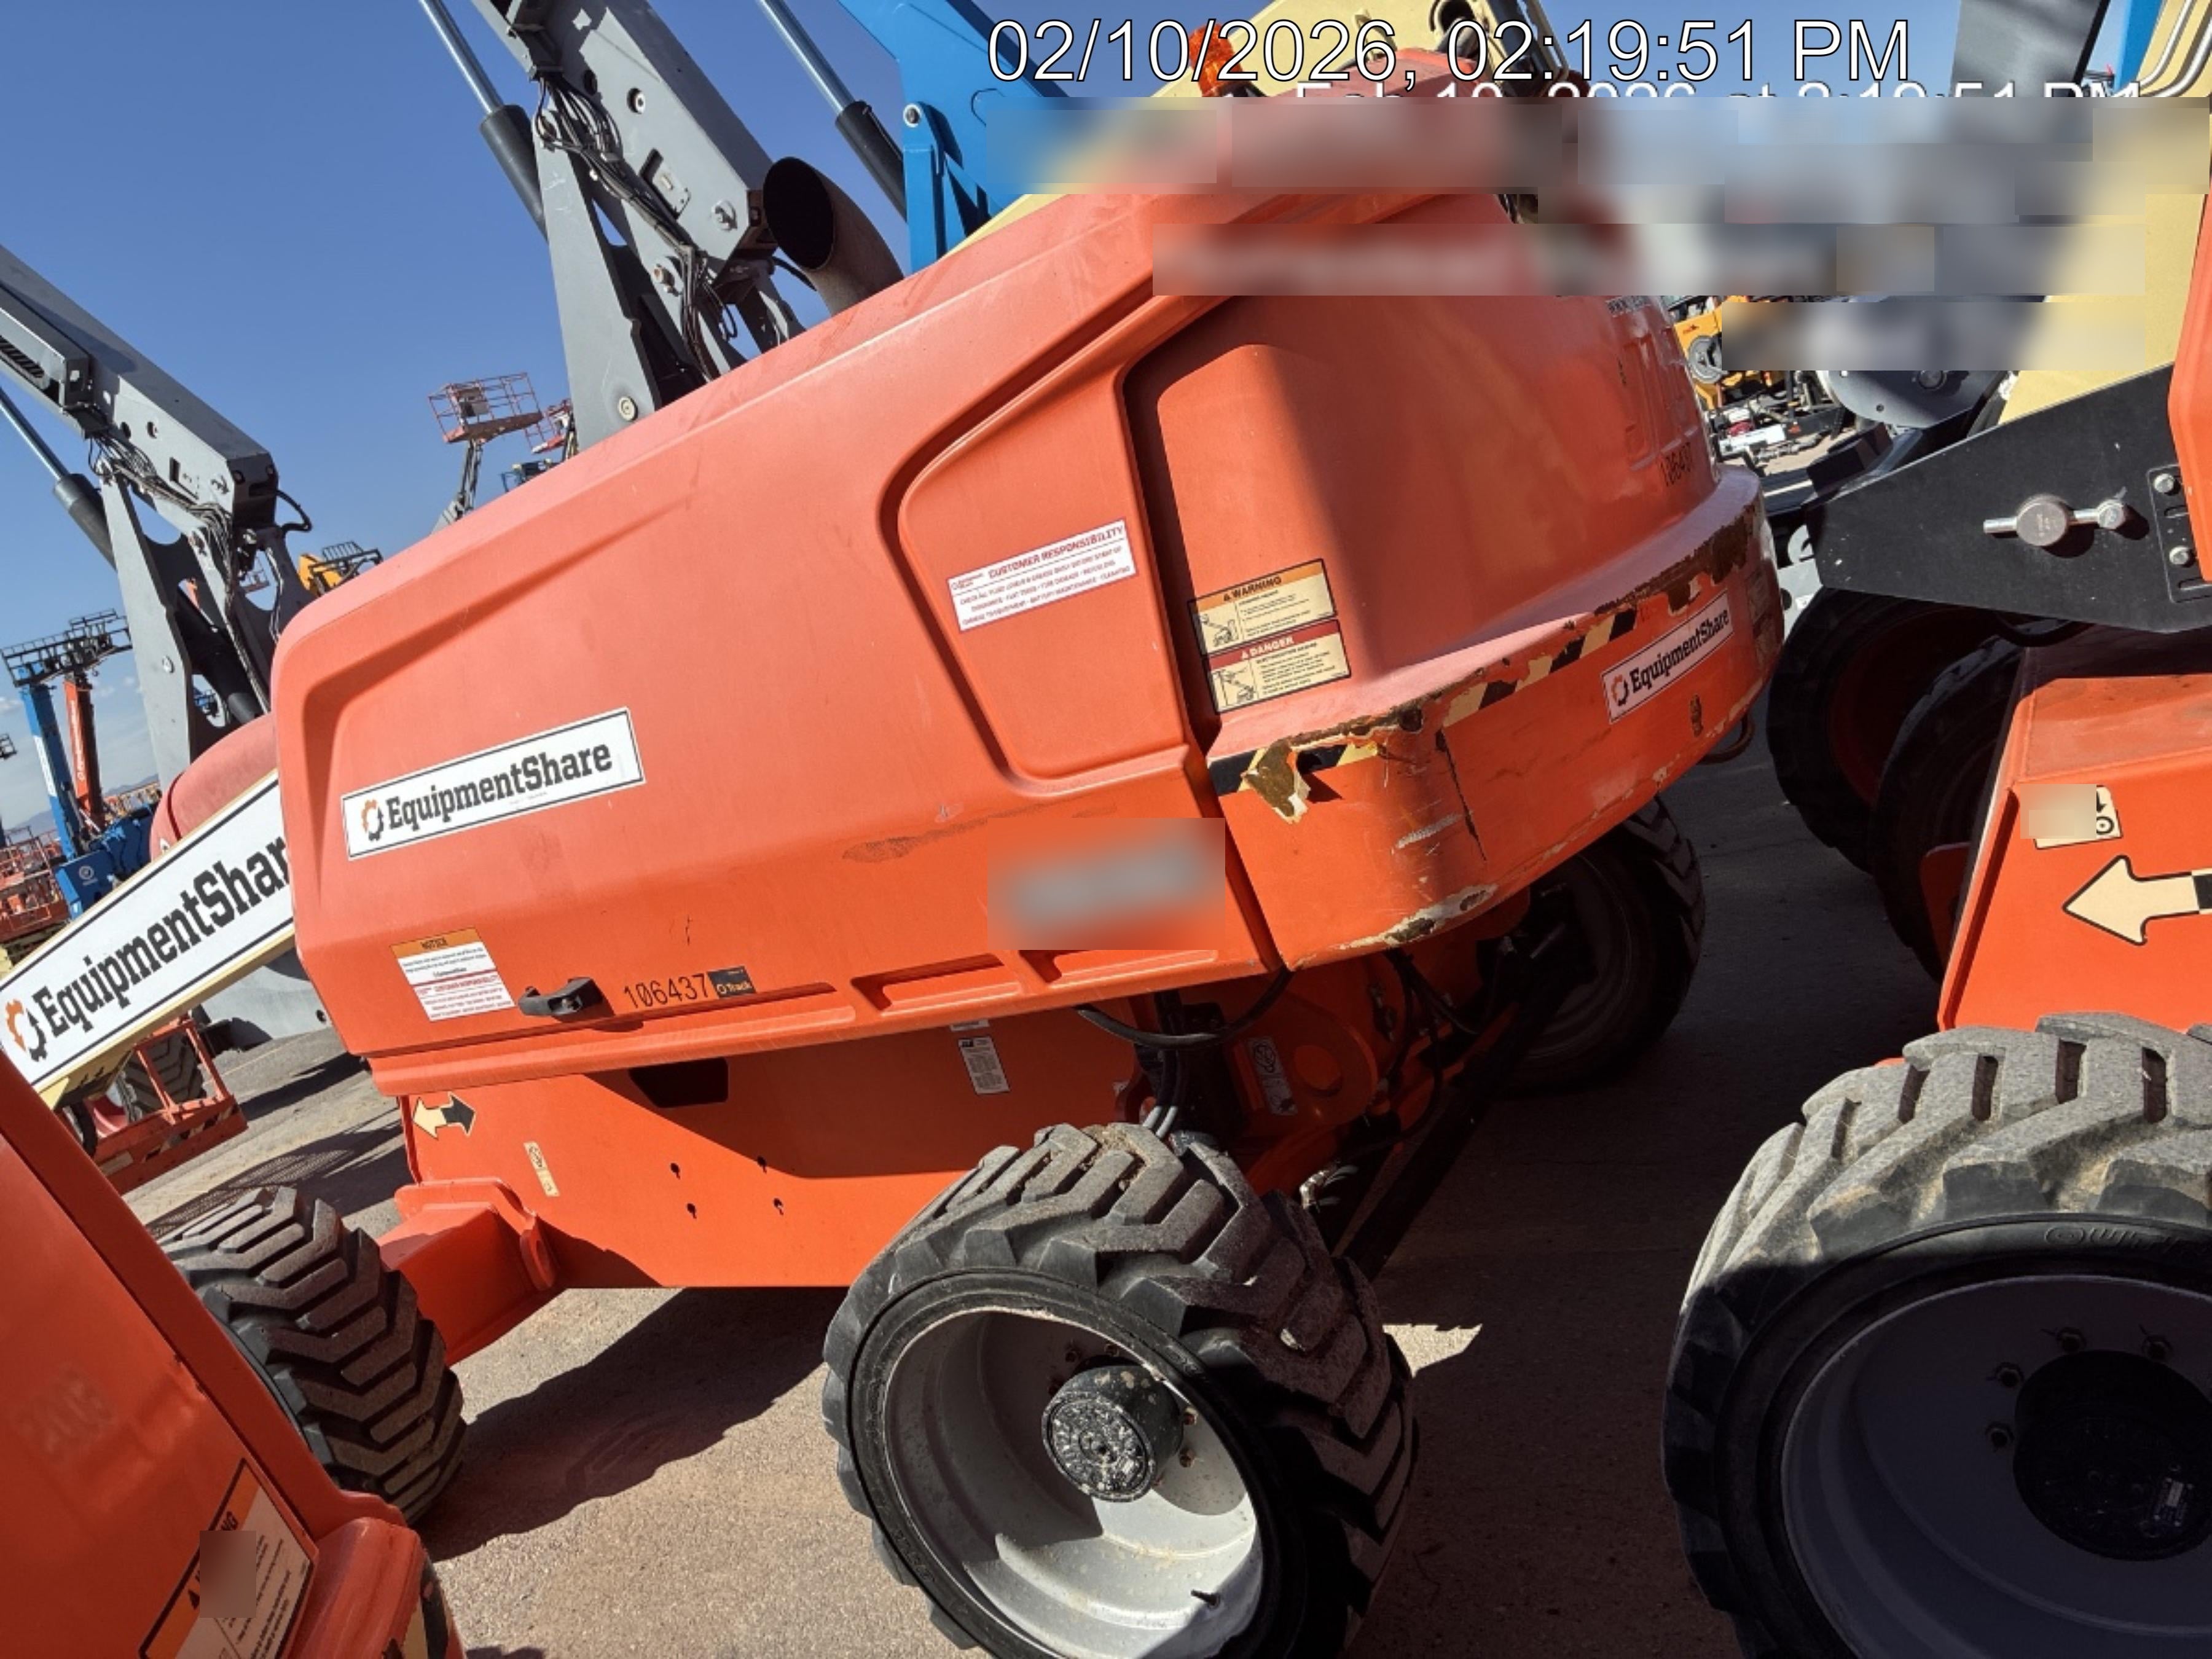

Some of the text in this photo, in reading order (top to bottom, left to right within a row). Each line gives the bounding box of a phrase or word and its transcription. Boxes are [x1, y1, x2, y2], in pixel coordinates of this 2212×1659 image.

[989, 555, 1040, 579] CUSTOMER
[1041, 525, 1123, 560] RESPONSIBILITY
[1233, 576, 1282, 598] WARNING
[1249, 637, 1294, 659] DANGER
[1630, 610, 1729, 694] EquipmentShare
[385, 743, 612, 831] EquipmentShare
[32, 836, 289, 1038] EquipmentShar
[624, 973, 708, 1008] 106437
